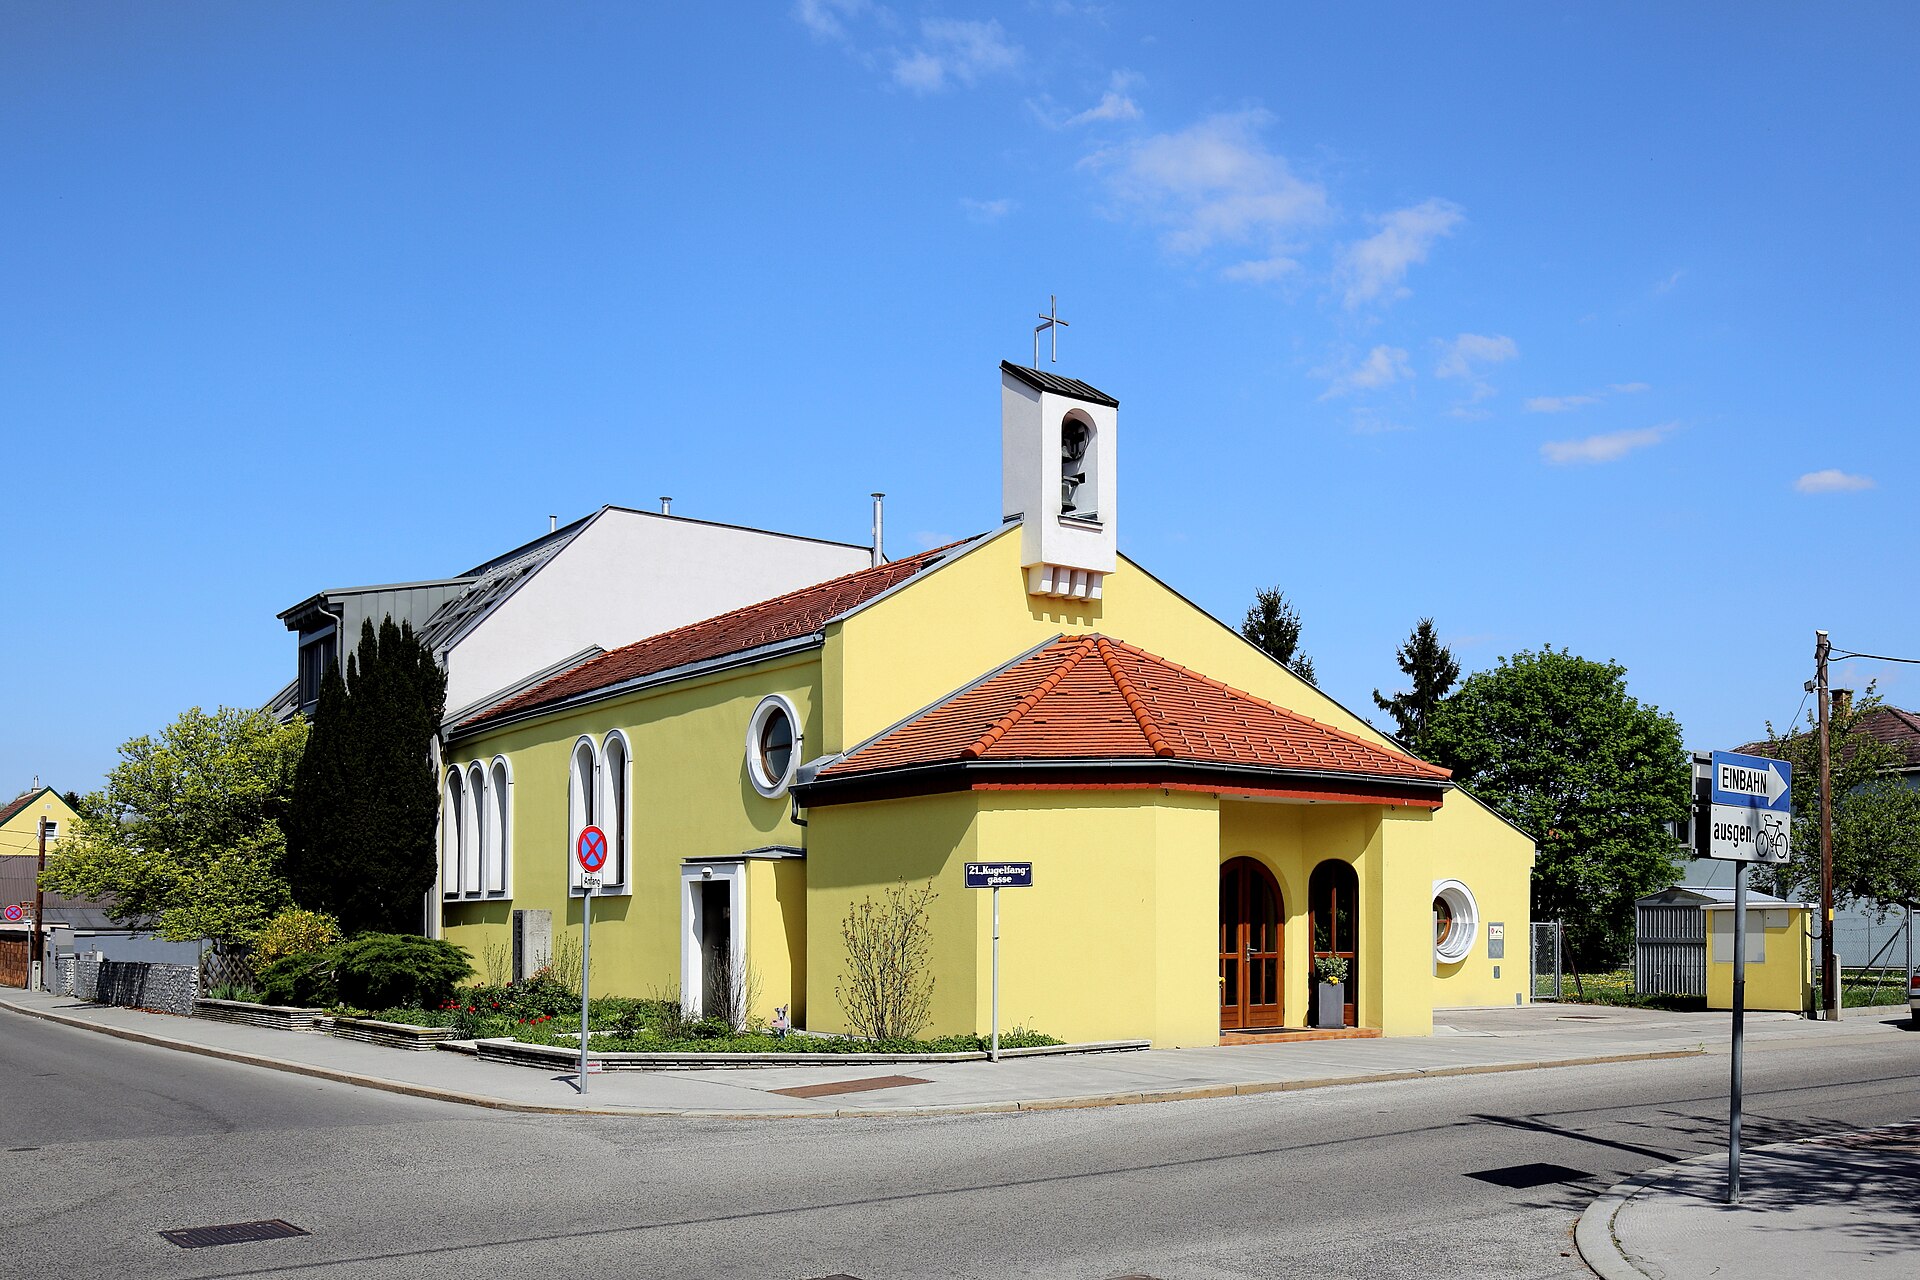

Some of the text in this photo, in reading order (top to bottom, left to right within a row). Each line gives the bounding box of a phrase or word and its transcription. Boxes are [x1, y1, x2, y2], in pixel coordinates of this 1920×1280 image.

[1722, 767, 1767, 794] EINBAHN
[1714, 822, 1755, 848] ausgen.
[584, 876, 601, 887] Anfang
[987, 876, 1012, 886] gasse
